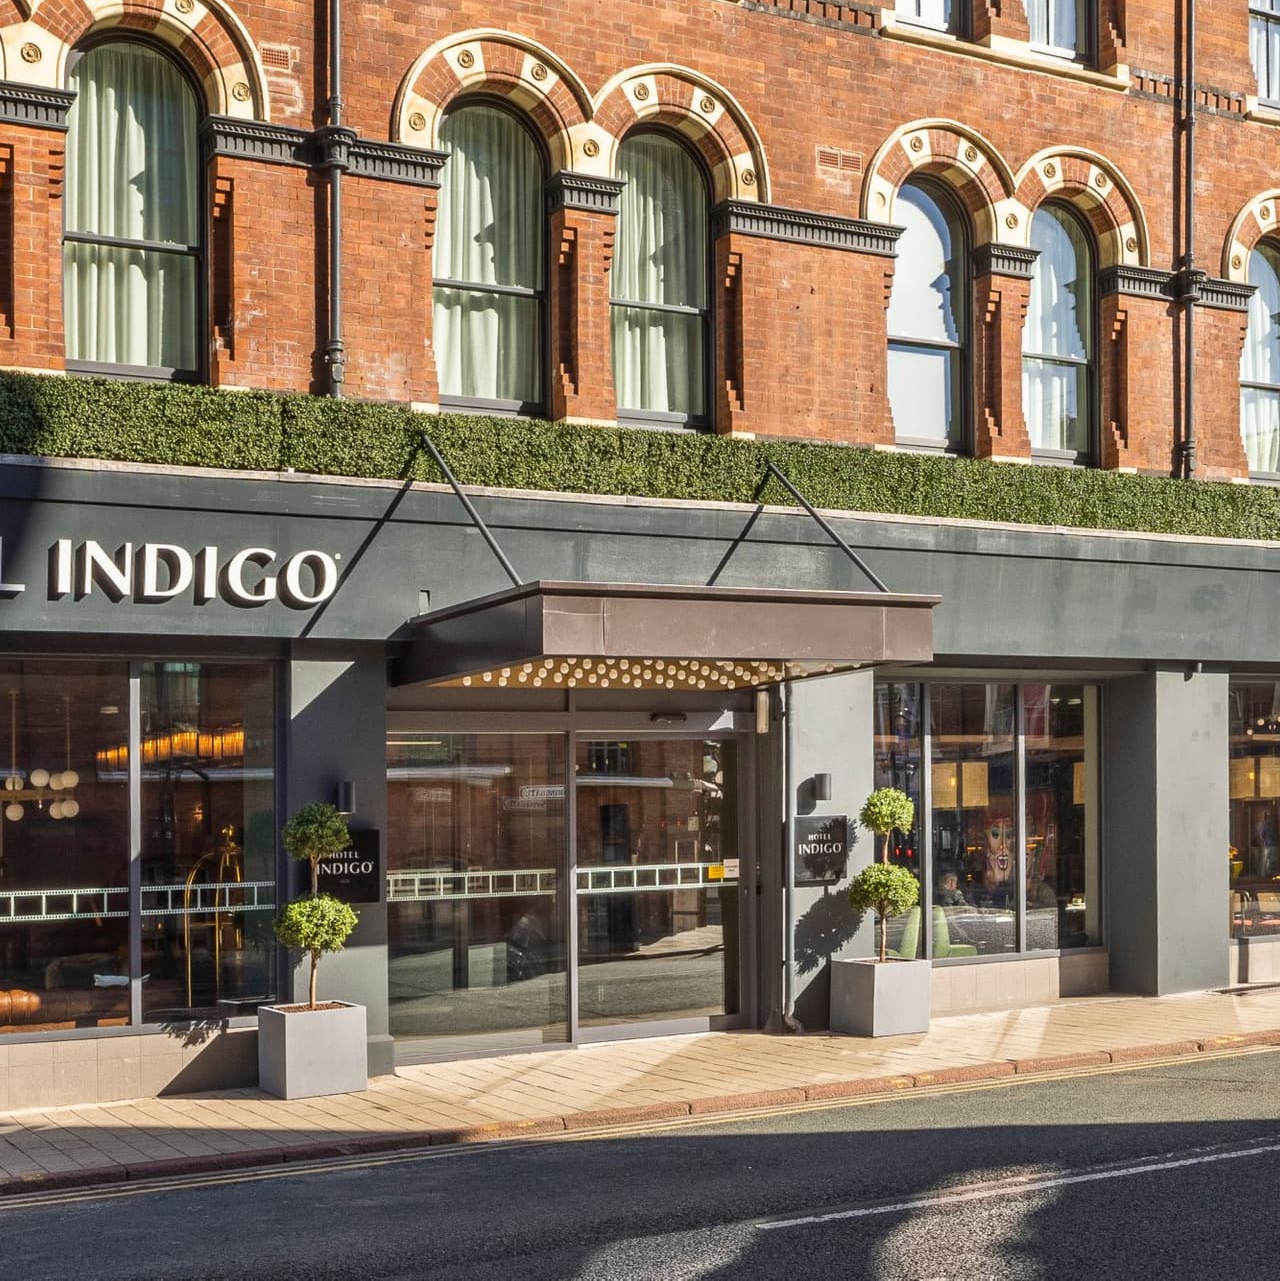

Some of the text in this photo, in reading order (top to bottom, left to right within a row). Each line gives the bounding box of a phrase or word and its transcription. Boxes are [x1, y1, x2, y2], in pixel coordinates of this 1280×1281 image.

[48, 538, 341, 604] INDIGO
[808, 833, 831, 841] HOTEL
[328, 850, 360, 860] HOTEL
[798, 842, 843, 856] INDIGO
[316, 861, 374, 876] INDIGO
